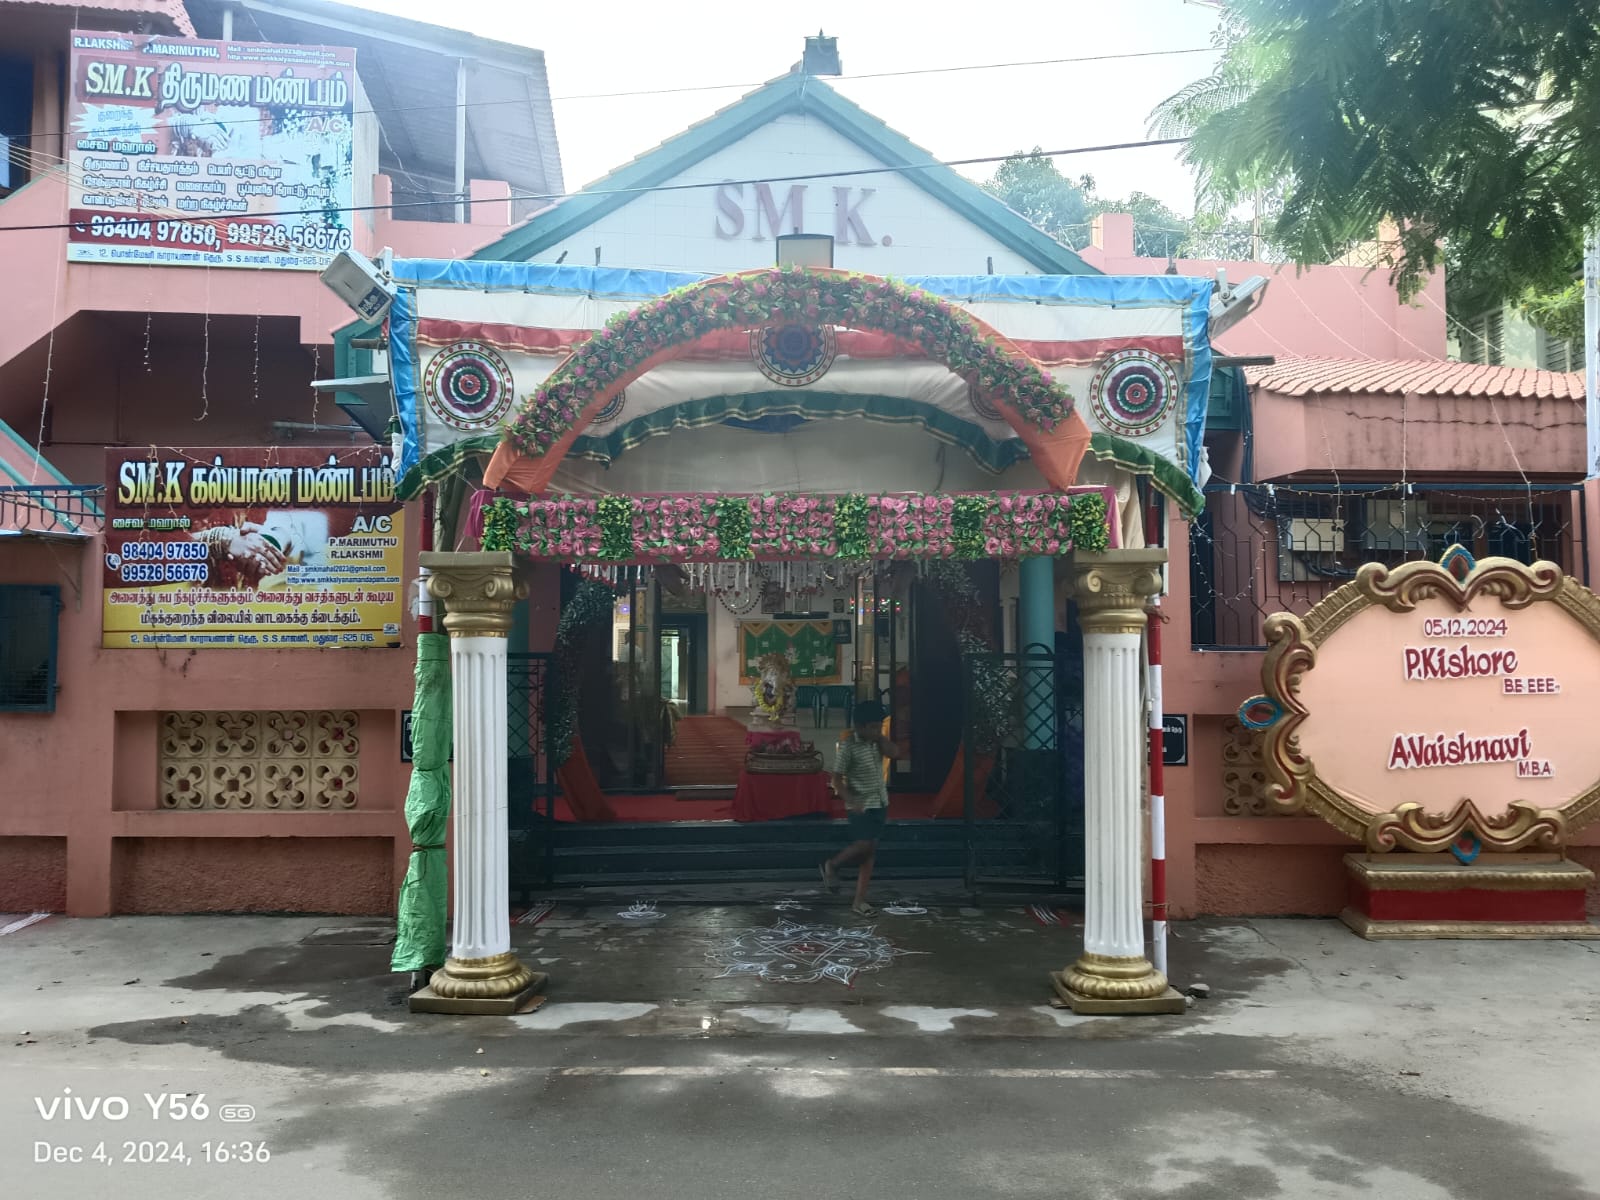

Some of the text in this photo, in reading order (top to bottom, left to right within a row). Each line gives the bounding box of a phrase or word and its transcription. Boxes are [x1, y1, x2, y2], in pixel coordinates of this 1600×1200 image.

[161, 62, 252, 110] திருமண
[255, 68, 347, 107] மண்டபம்
[307, 116, 343, 133] A/C
[83, 157, 129, 171] திருமணம்
[91, 215, 351, 250] 98404 97850, 99526 56676
[118, 455, 396, 505] SM.K கல்யாண மண்டபம்
[352, 515, 393, 533] A/C
[123, 543, 207, 559] 98404 97850
[329, 537, 398, 547] P.MARIMUTHU
[331, 550, 383, 559] R.LAKSHMI
[122, 565, 207, 580] 99526 56676
[110, 589, 156, 606] அனைத்து
[158, 593, 172, 603] சுப
[174, 588, 253, 605] நிகழ்ச்சிகளுக்கும்
[255, 588, 303, 606] அனைத்து
[366, 592, 394, 605] கூடிய
[140, 609, 205, 626] மிகக்குறைந்த
[207, 609, 253, 624] விலையில்
[255, 610, 309, 625] வாடகைக்கு
[1424, 618, 1508, 636] 05.12.2024
[1405, 644, 1519, 680] P.Kishore
[1389, 728, 1532, 769] A.Vaishnavi
